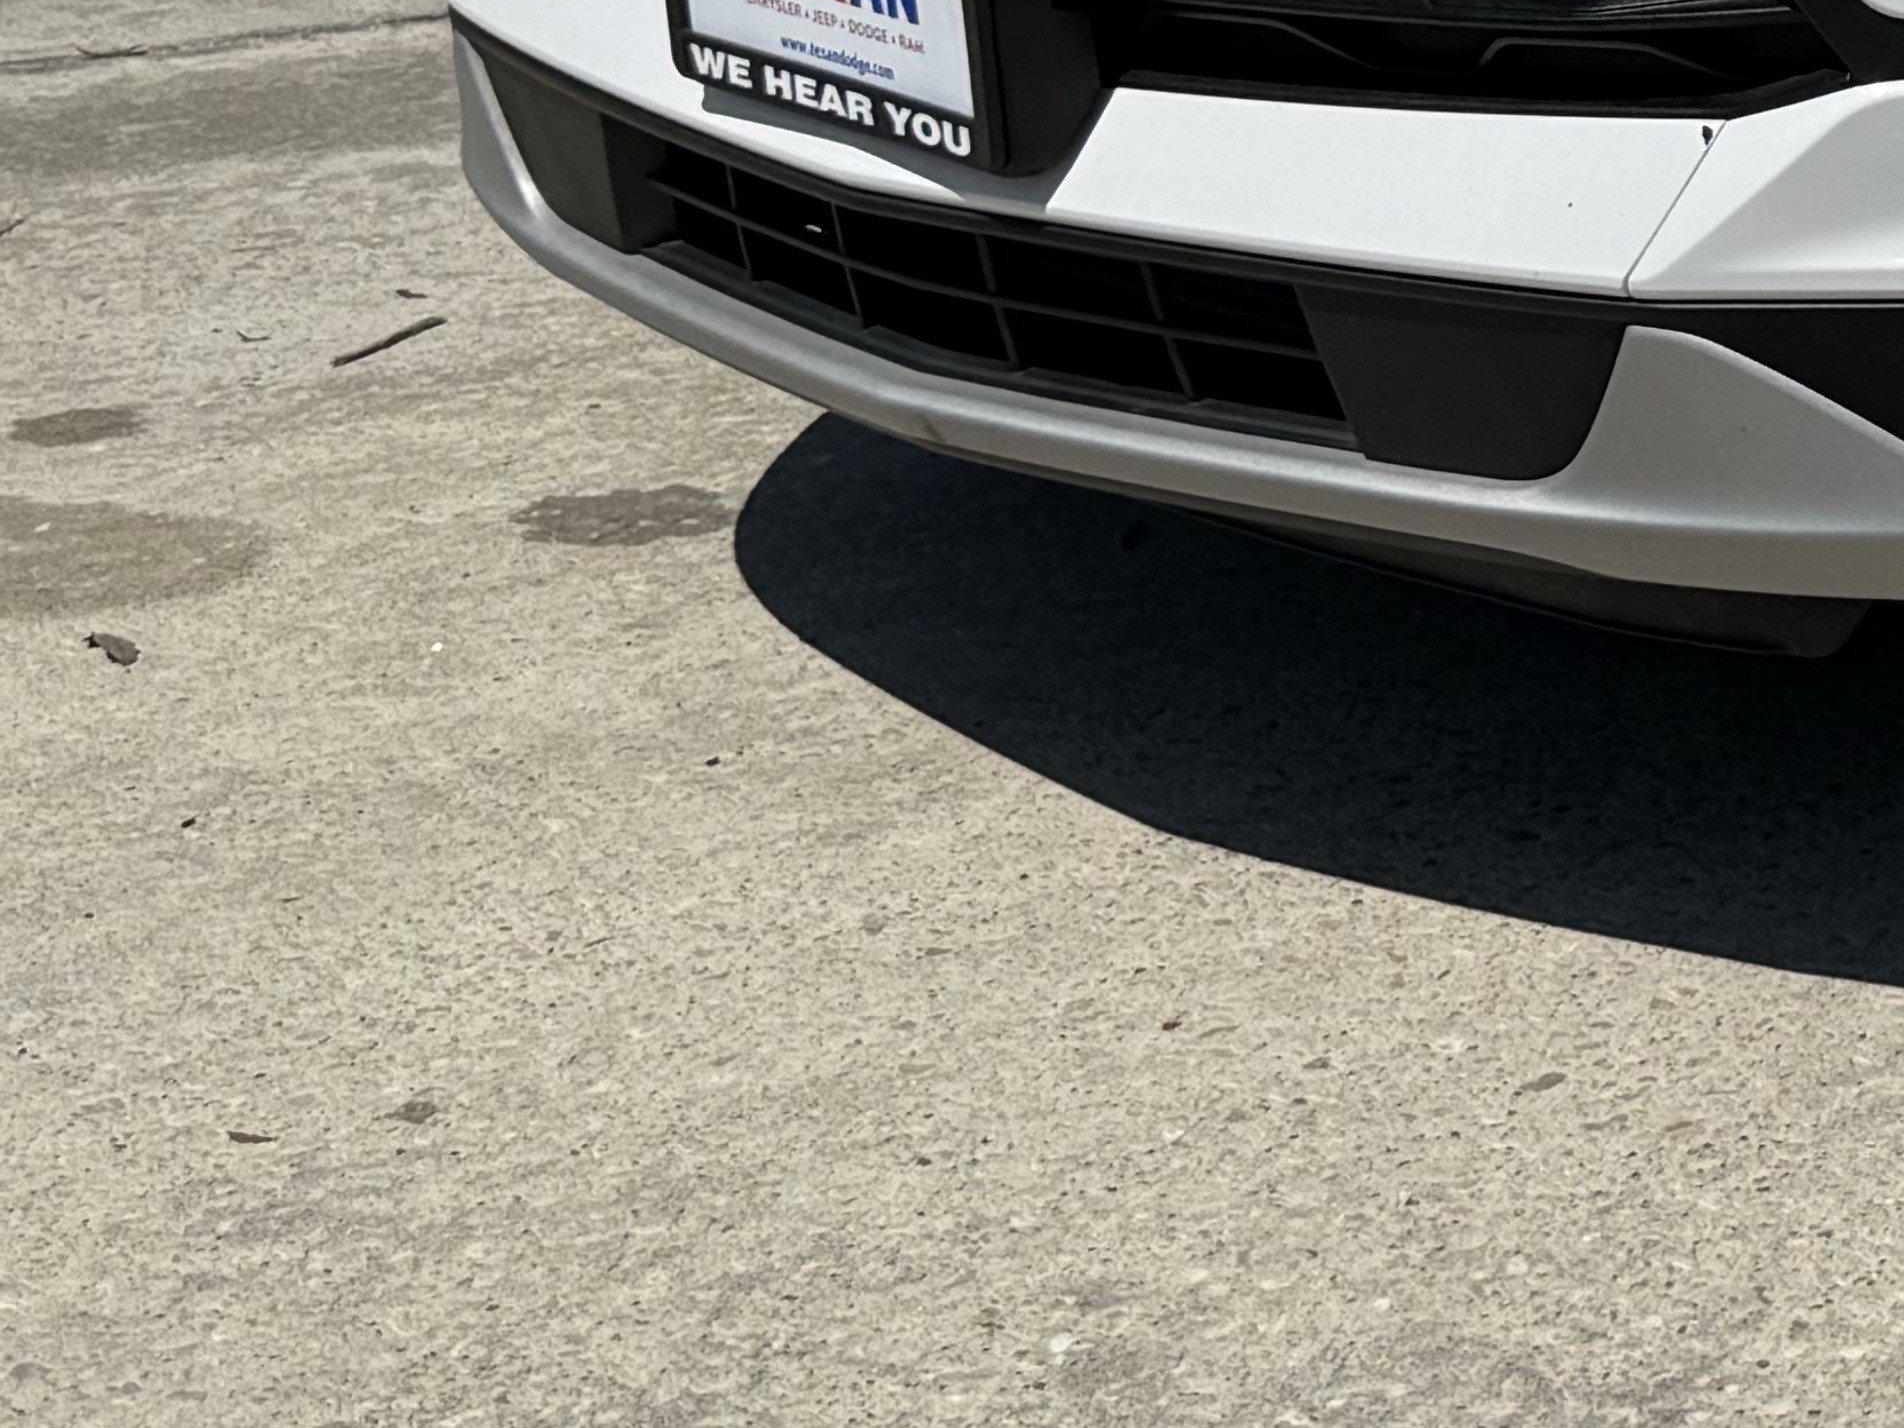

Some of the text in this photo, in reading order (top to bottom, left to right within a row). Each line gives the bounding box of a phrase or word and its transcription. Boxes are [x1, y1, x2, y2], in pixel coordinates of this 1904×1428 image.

[812, 5, 838, 27] JEEP
[847, 18, 889, 45] DODGE
[899, 33, 926, 55] RAM
[689, 43, 973, 158] WE HEAR YOU
